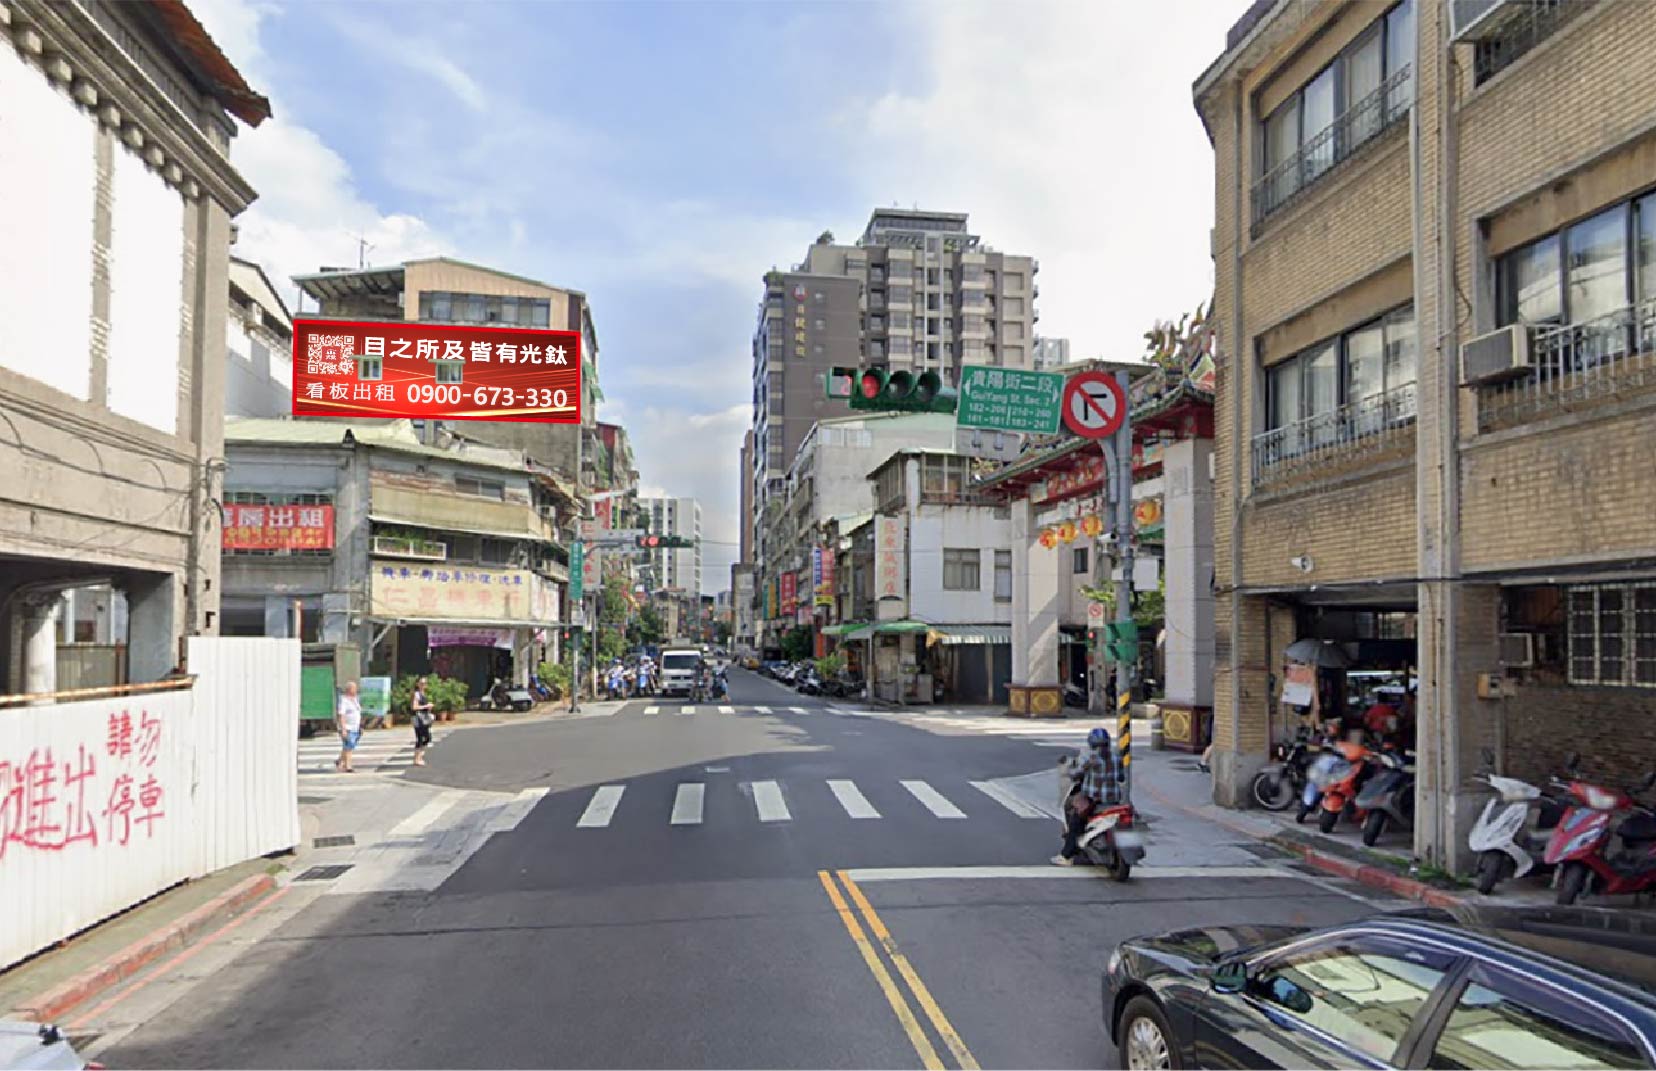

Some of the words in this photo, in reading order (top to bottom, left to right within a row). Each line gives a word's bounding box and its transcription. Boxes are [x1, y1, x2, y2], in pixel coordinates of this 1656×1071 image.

[363, 335, 568, 366] 目之所及皆有光鈦
[305, 382, 396, 402] 看板出租
[406, 383, 568, 408] 0900-673-330
[106, 709, 161, 767] 請勿
[102, 773, 166, 846] 停車
